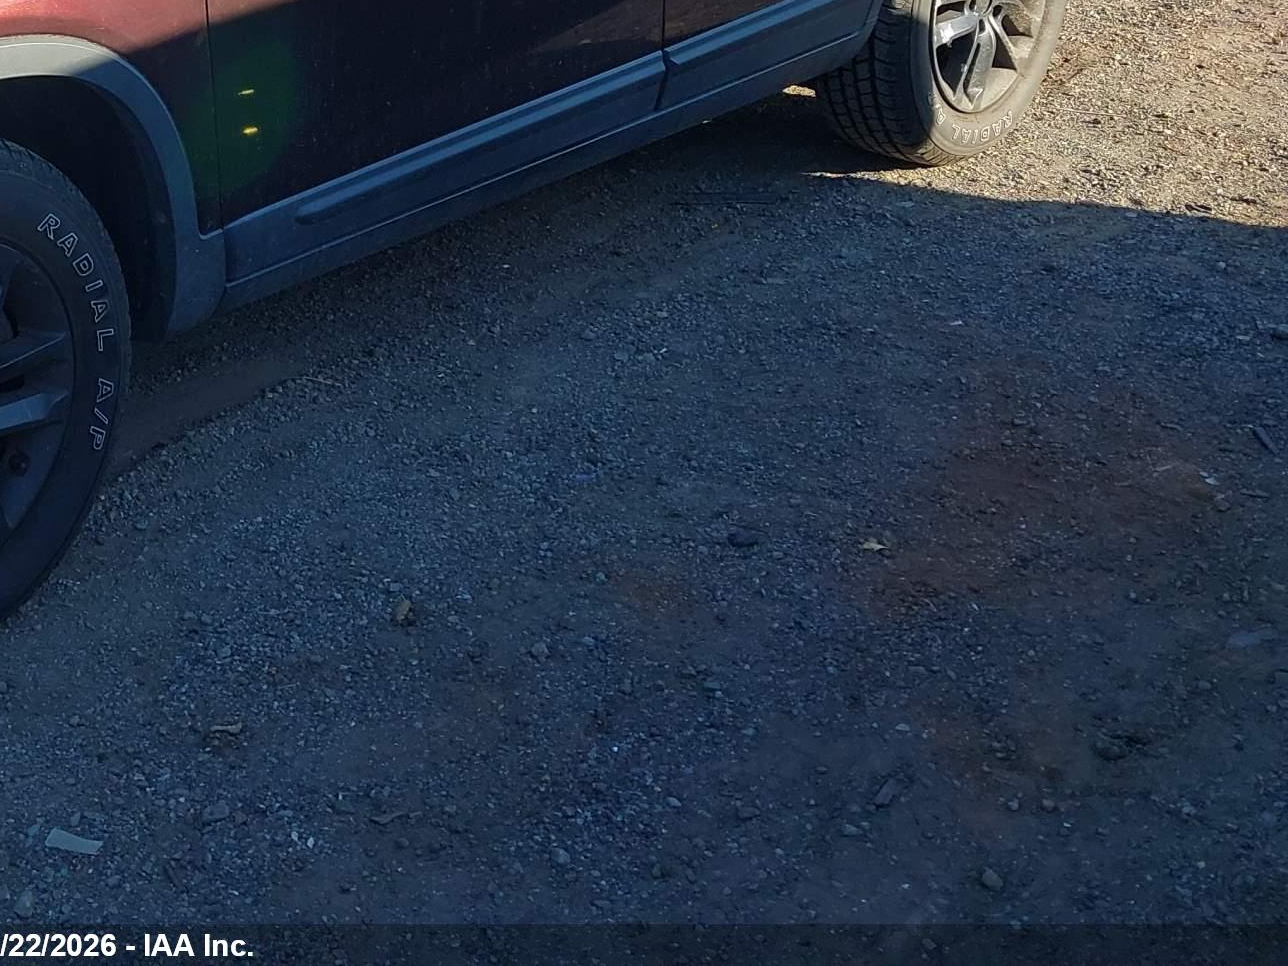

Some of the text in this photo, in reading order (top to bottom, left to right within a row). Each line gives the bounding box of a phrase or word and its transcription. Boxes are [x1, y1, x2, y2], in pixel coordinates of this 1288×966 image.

[951, 110, 1014, 144] RADIAL
[37, 212, 117, 452] RADIAL A/P
